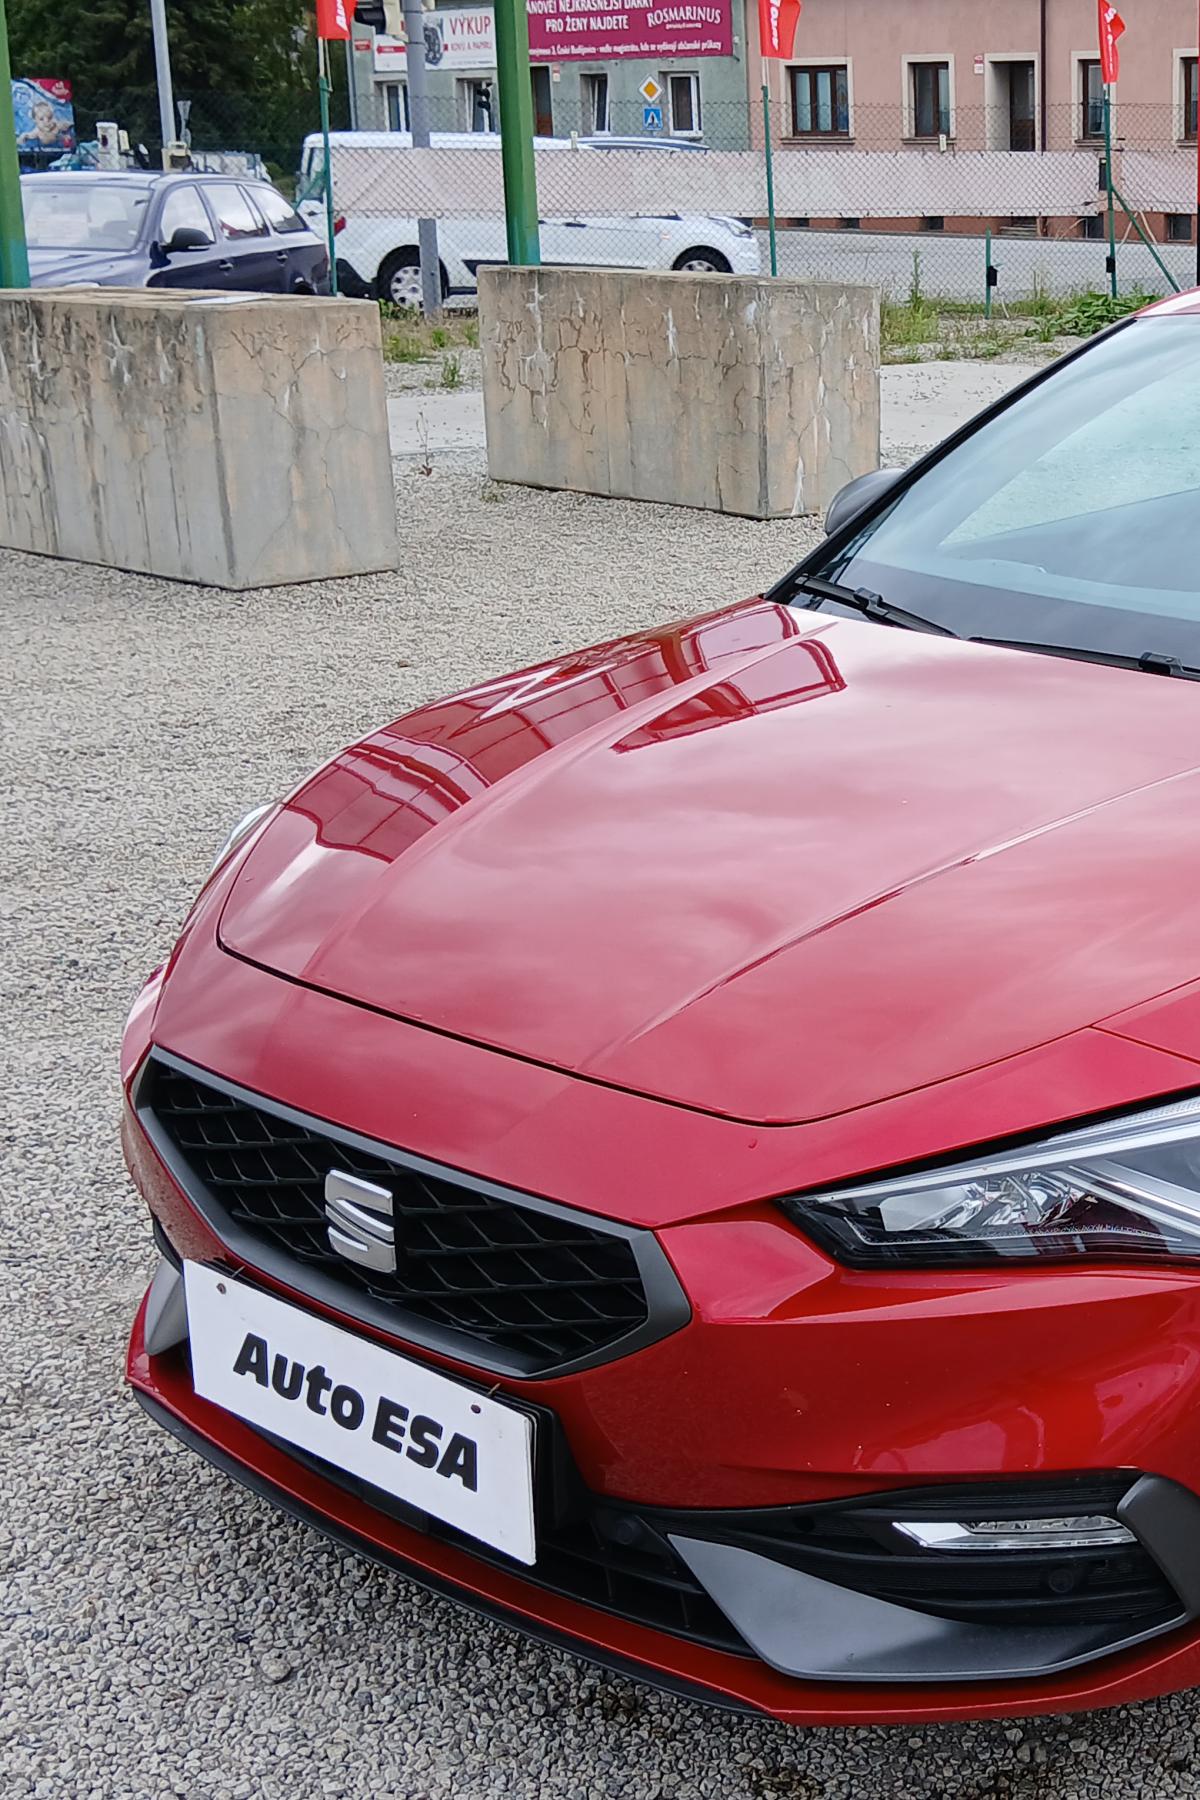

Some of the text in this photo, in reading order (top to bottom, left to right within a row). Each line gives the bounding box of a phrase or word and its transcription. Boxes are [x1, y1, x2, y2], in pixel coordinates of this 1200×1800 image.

[450, 13, 491, 35] VÝKUP
[545, 15, 629, 32] PRO ŽENY NAJDETE
[646, 6, 721, 28] ROSMARINUS
[232, 1332, 478, 1493] Auto ESA
